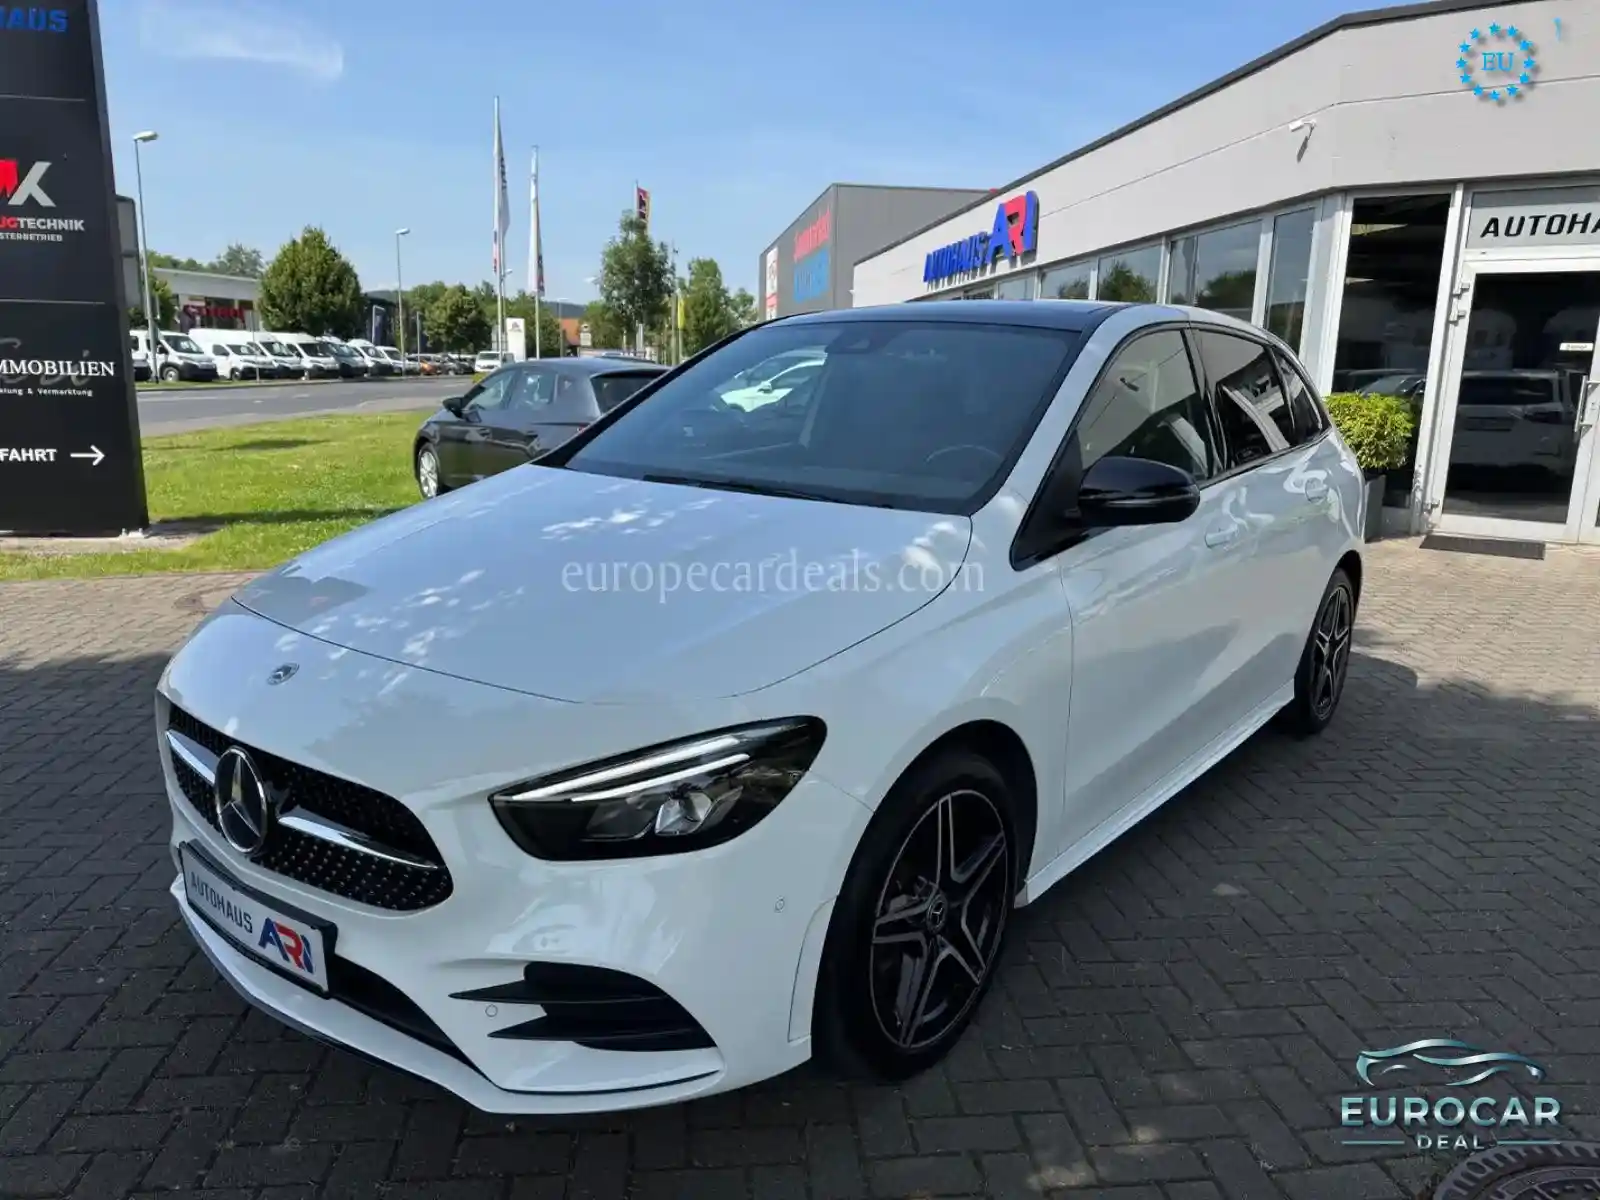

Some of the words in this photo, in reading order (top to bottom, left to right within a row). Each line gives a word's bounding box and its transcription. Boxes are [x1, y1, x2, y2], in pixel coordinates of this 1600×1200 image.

[923, 231, 988, 283] AUTOHAUS
[985, 190, 1039, 264] ARI
[37, 388, 93, 397] Vermarktung
[0, 447, 58, 462] FAHRT
[190, 871, 254, 934] AUTOHAUS
[257, 917, 316, 975] ARI
